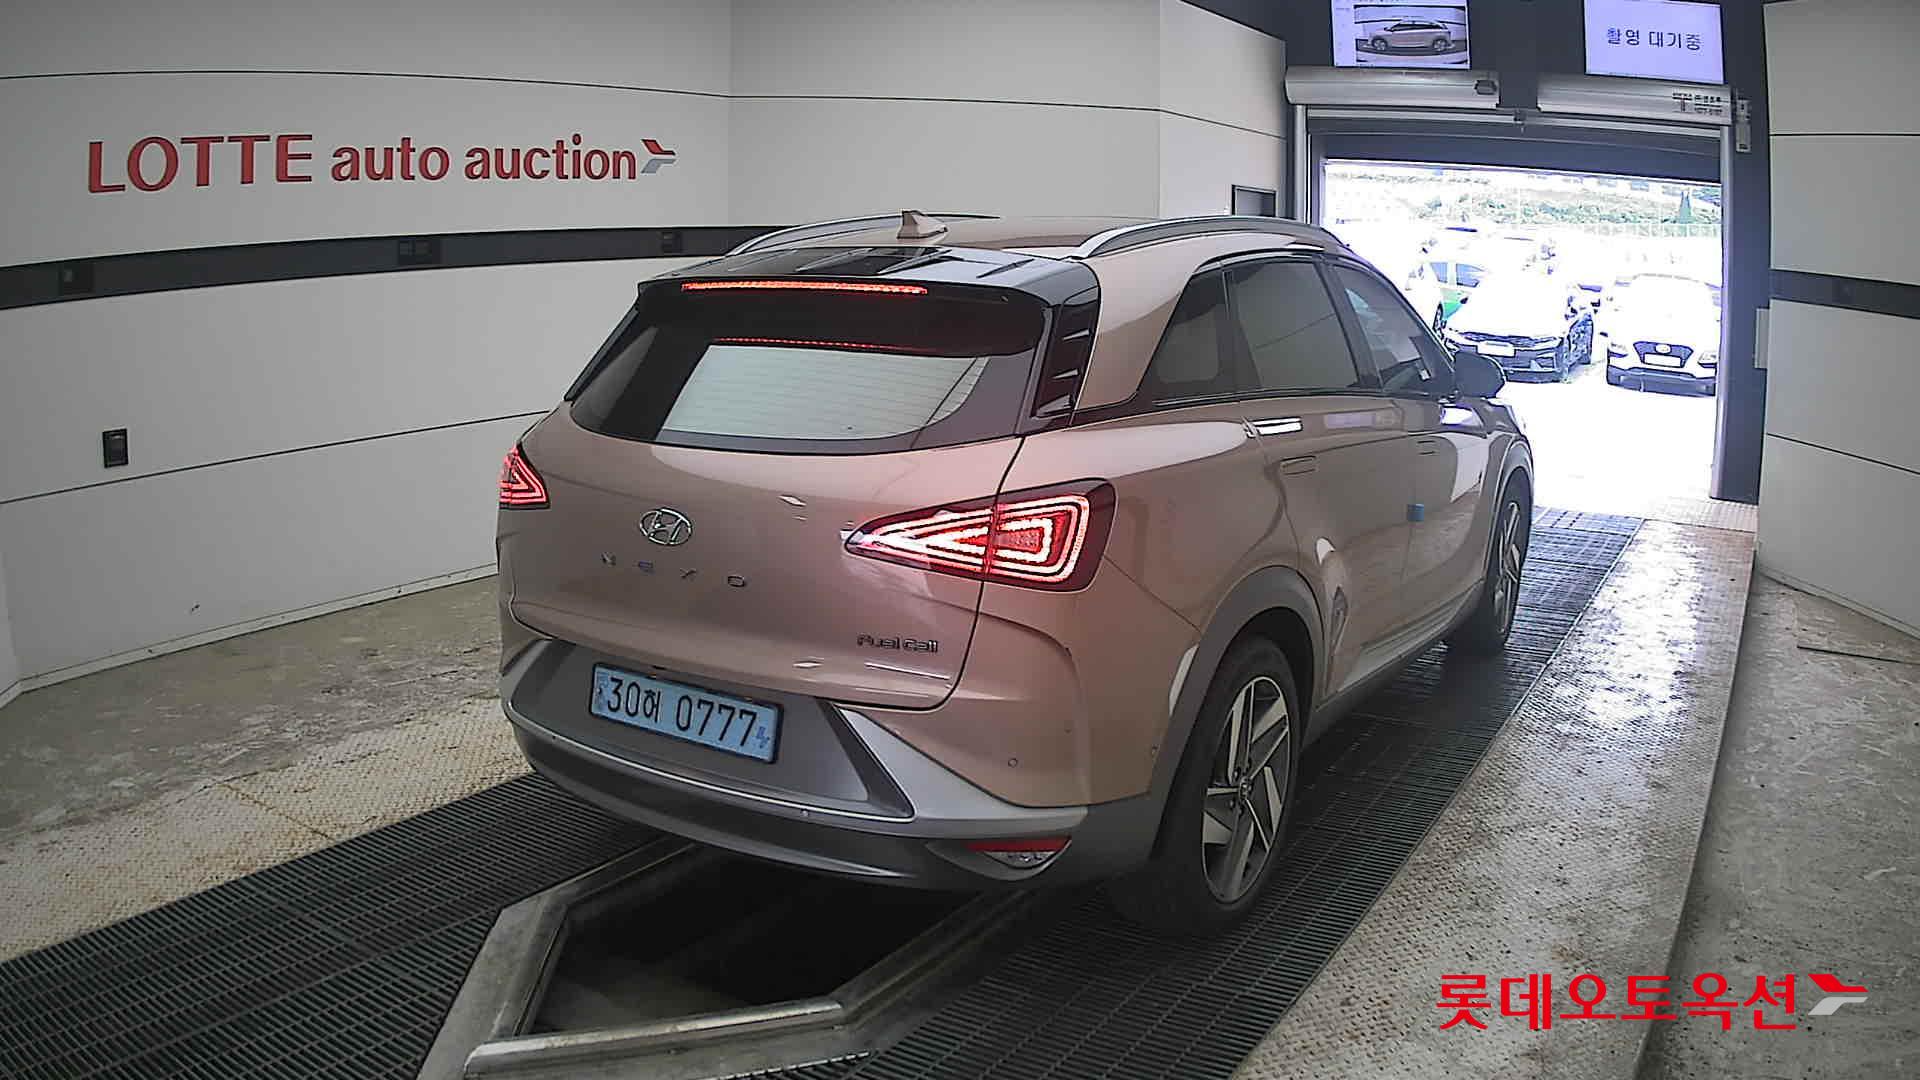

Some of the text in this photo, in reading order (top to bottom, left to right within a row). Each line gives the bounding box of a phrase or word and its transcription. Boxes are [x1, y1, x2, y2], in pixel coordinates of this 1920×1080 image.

[1649, 31, 1701, 51] 대기중
[88, 132, 637, 193] LOTTE auto auction
[607, 676, 758, 747] 30허 0777
